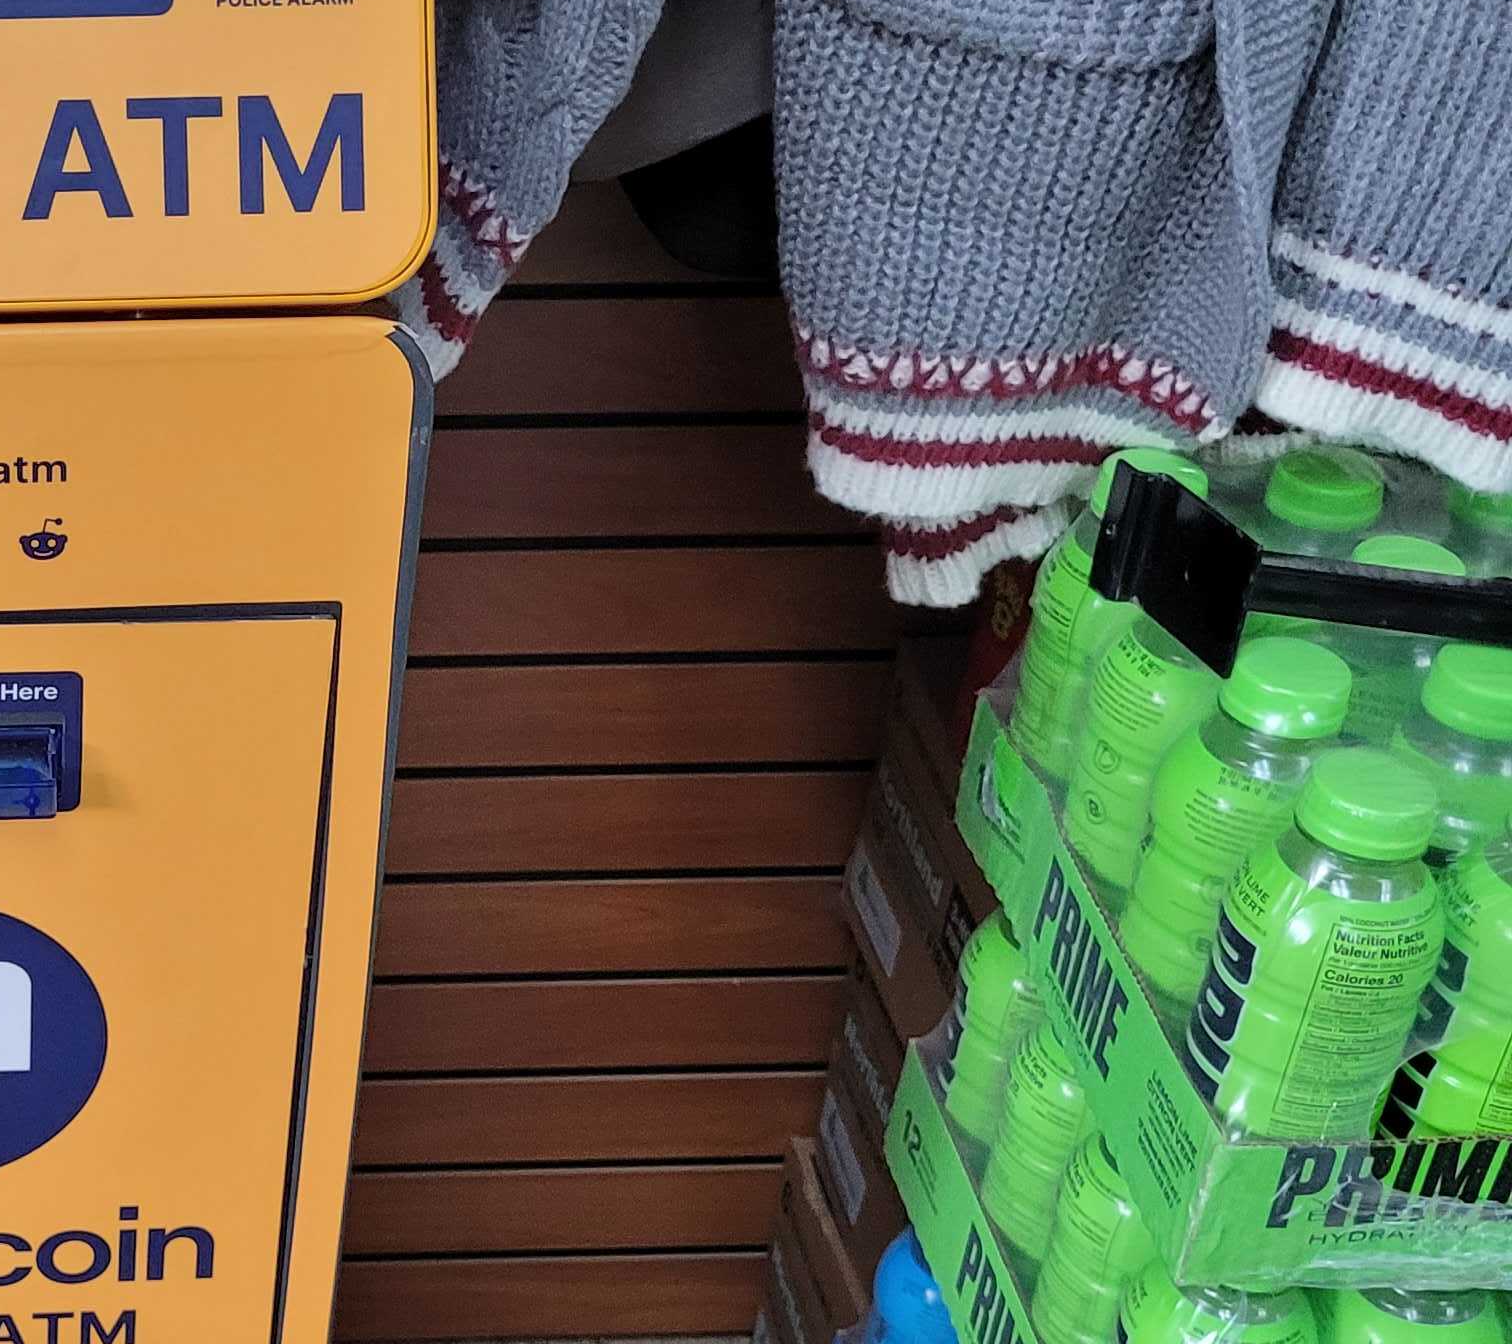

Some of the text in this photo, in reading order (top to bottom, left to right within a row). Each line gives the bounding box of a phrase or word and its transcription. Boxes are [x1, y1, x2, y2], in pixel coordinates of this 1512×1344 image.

[23, 93, 365, 221] ATM
[0, 681, 59, 701] Here
[1336, 929, 1425, 947] Nutrition Facts
[1333, 942, 1428, 959] Valeur Nutritive
[1033, 856, 1129, 1083] PRIME
[1324, 969, 1404, 986] Calories 20
[1266, 1141, 1512, 1227] PRIM
